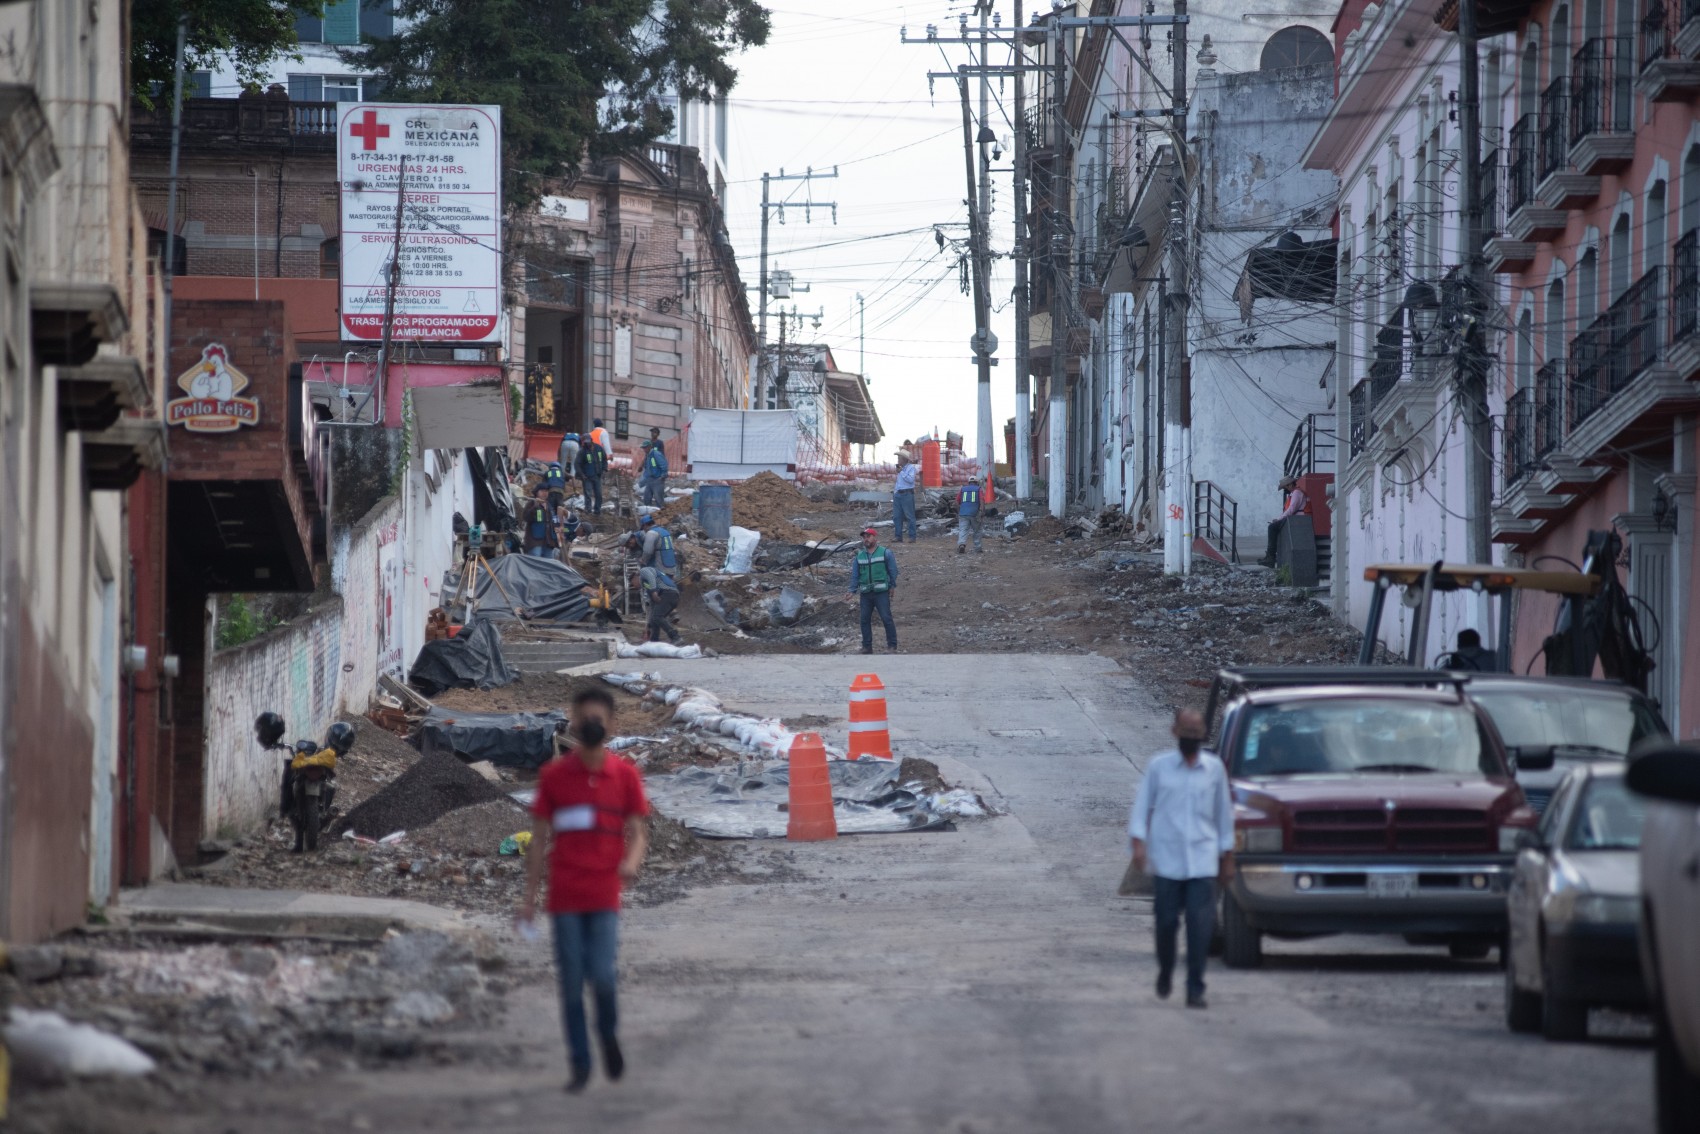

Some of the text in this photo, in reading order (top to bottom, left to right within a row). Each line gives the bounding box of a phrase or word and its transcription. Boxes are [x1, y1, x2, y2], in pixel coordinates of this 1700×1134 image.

[405, 131, 479, 141] MEXICANA
[351, 153, 398, 161] 8-17-34-31
[406, 154, 454, 162] 8-17-81-58
[426, 165, 438, 173] 24
[441, 166, 467, 174] HRS.
[361, 235, 478, 245] SERVICO ULTRASONIDO
[367, 289, 441, 298] LABRATORIOS
[411, 318, 490, 327] PROGRAMADOS
[397, 328, 462, 337] AMBULANCIA
[174, 401, 252, 418] Pollo Feliz
